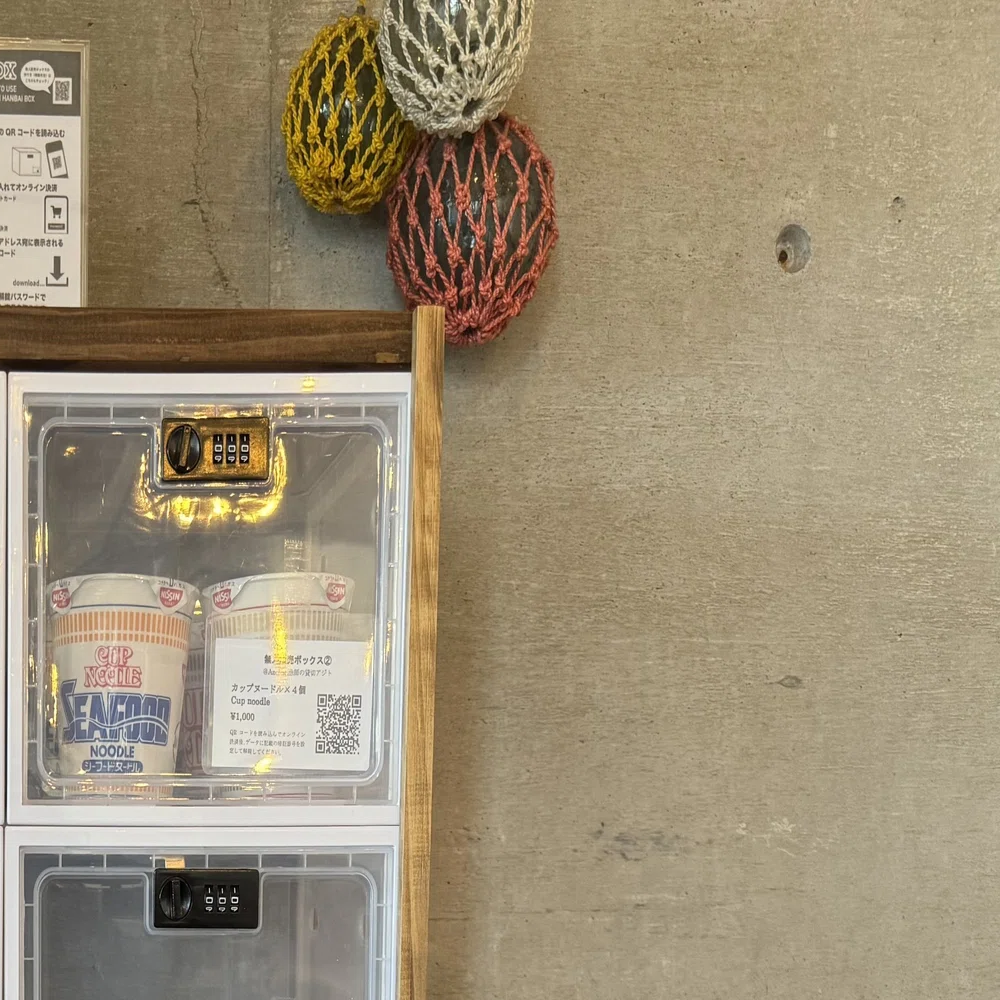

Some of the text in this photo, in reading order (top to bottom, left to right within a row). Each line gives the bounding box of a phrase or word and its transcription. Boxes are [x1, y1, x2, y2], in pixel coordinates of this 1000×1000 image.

[161, 590, 180, 601] NISSIN
[95, 646, 133, 666] CUP
[231, 696, 270, 706] Cup noodle
[61, 679, 171, 746] SEAFOOD
[230, 712, 255, 722] ¥1,000
[90, 744, 135, 758] NOODLE
